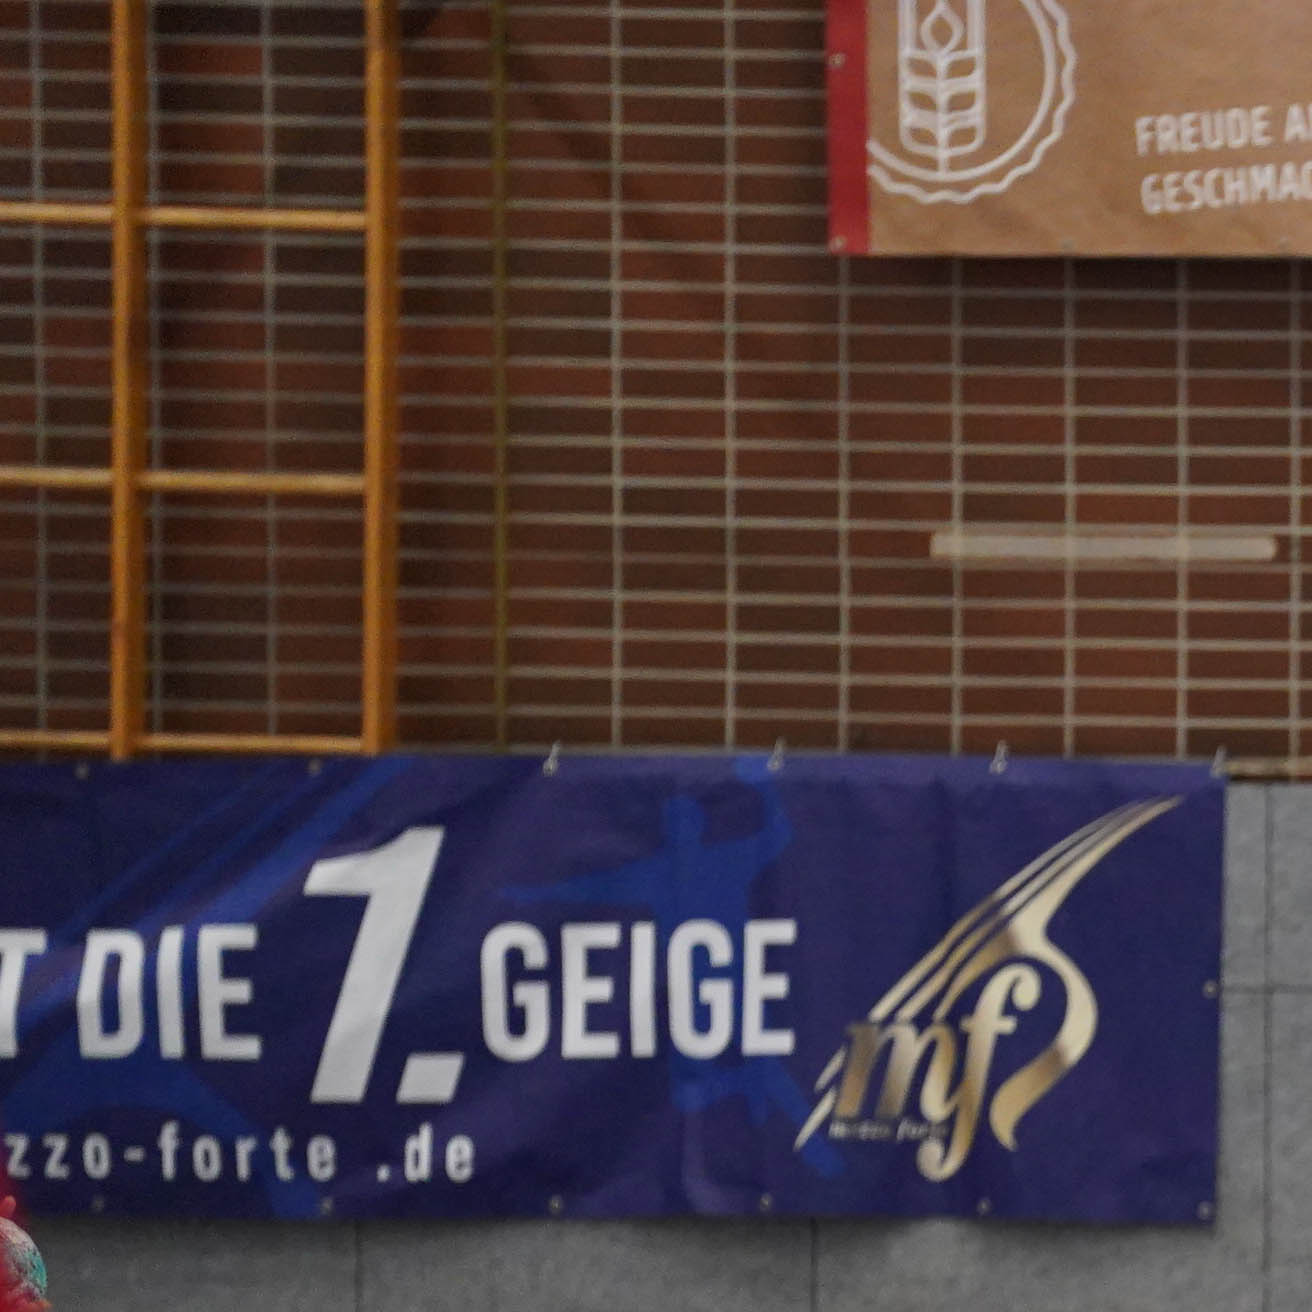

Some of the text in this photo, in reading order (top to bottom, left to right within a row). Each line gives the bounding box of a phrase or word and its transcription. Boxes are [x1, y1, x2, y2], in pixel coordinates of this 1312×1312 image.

[1135, 105, 1274, 156] FREUDE
[77, 923, 262, 1061] DIE
[303, 825, 465, 1104] 1.
[480, 919, 798, 1062] GEIGE
[3, 1120, 337, 1182] zzo-forte
